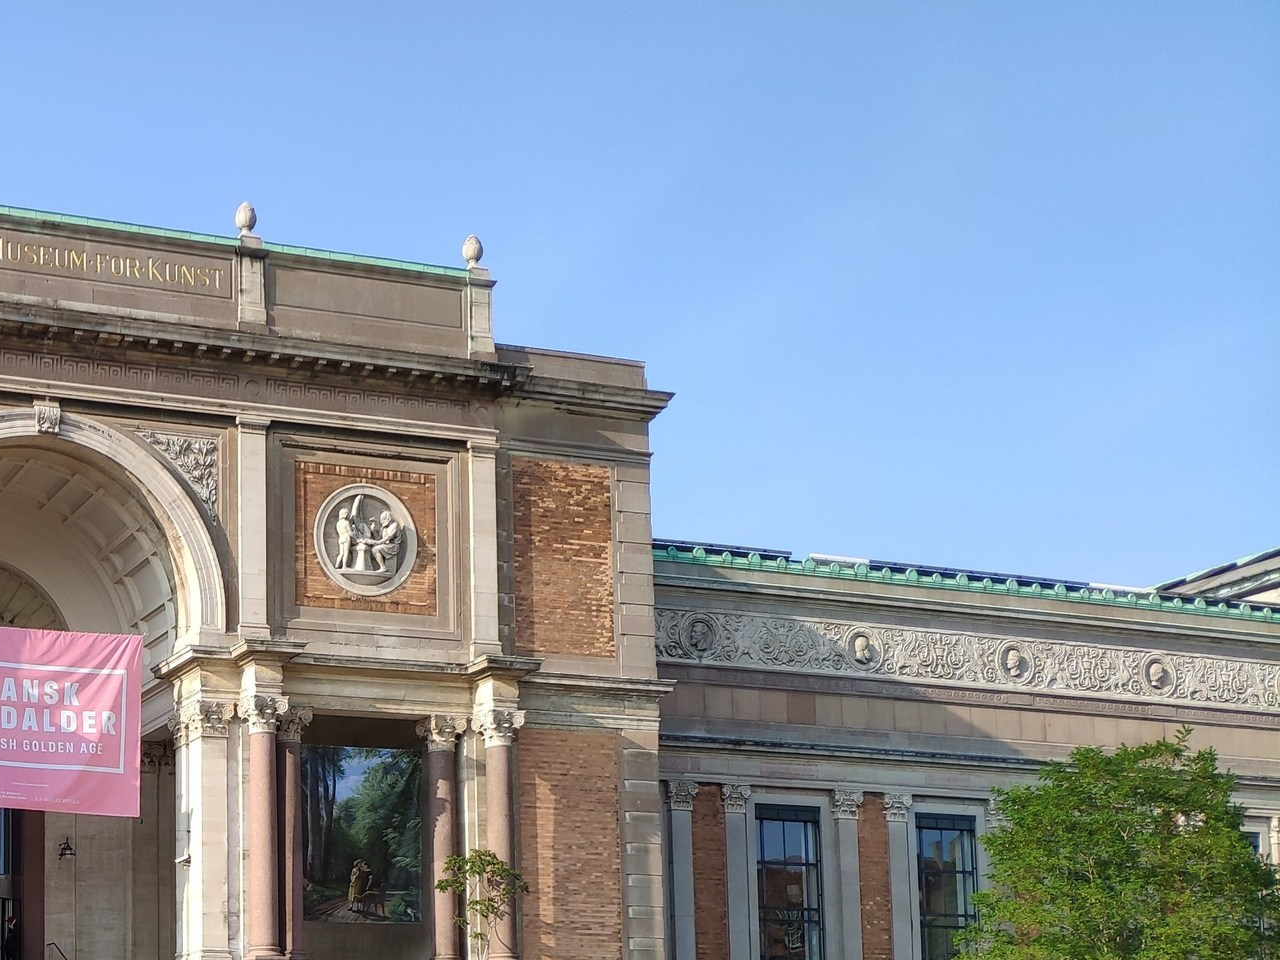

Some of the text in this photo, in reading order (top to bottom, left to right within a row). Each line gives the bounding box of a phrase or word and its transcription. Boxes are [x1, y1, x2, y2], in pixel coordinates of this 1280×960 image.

[95, 252, 140, 278] FOR
[146, 256, 224, 290] KUNST
[22, 740, 74, 753] GOLDEN
[80, 742, 103, 755] AGE
